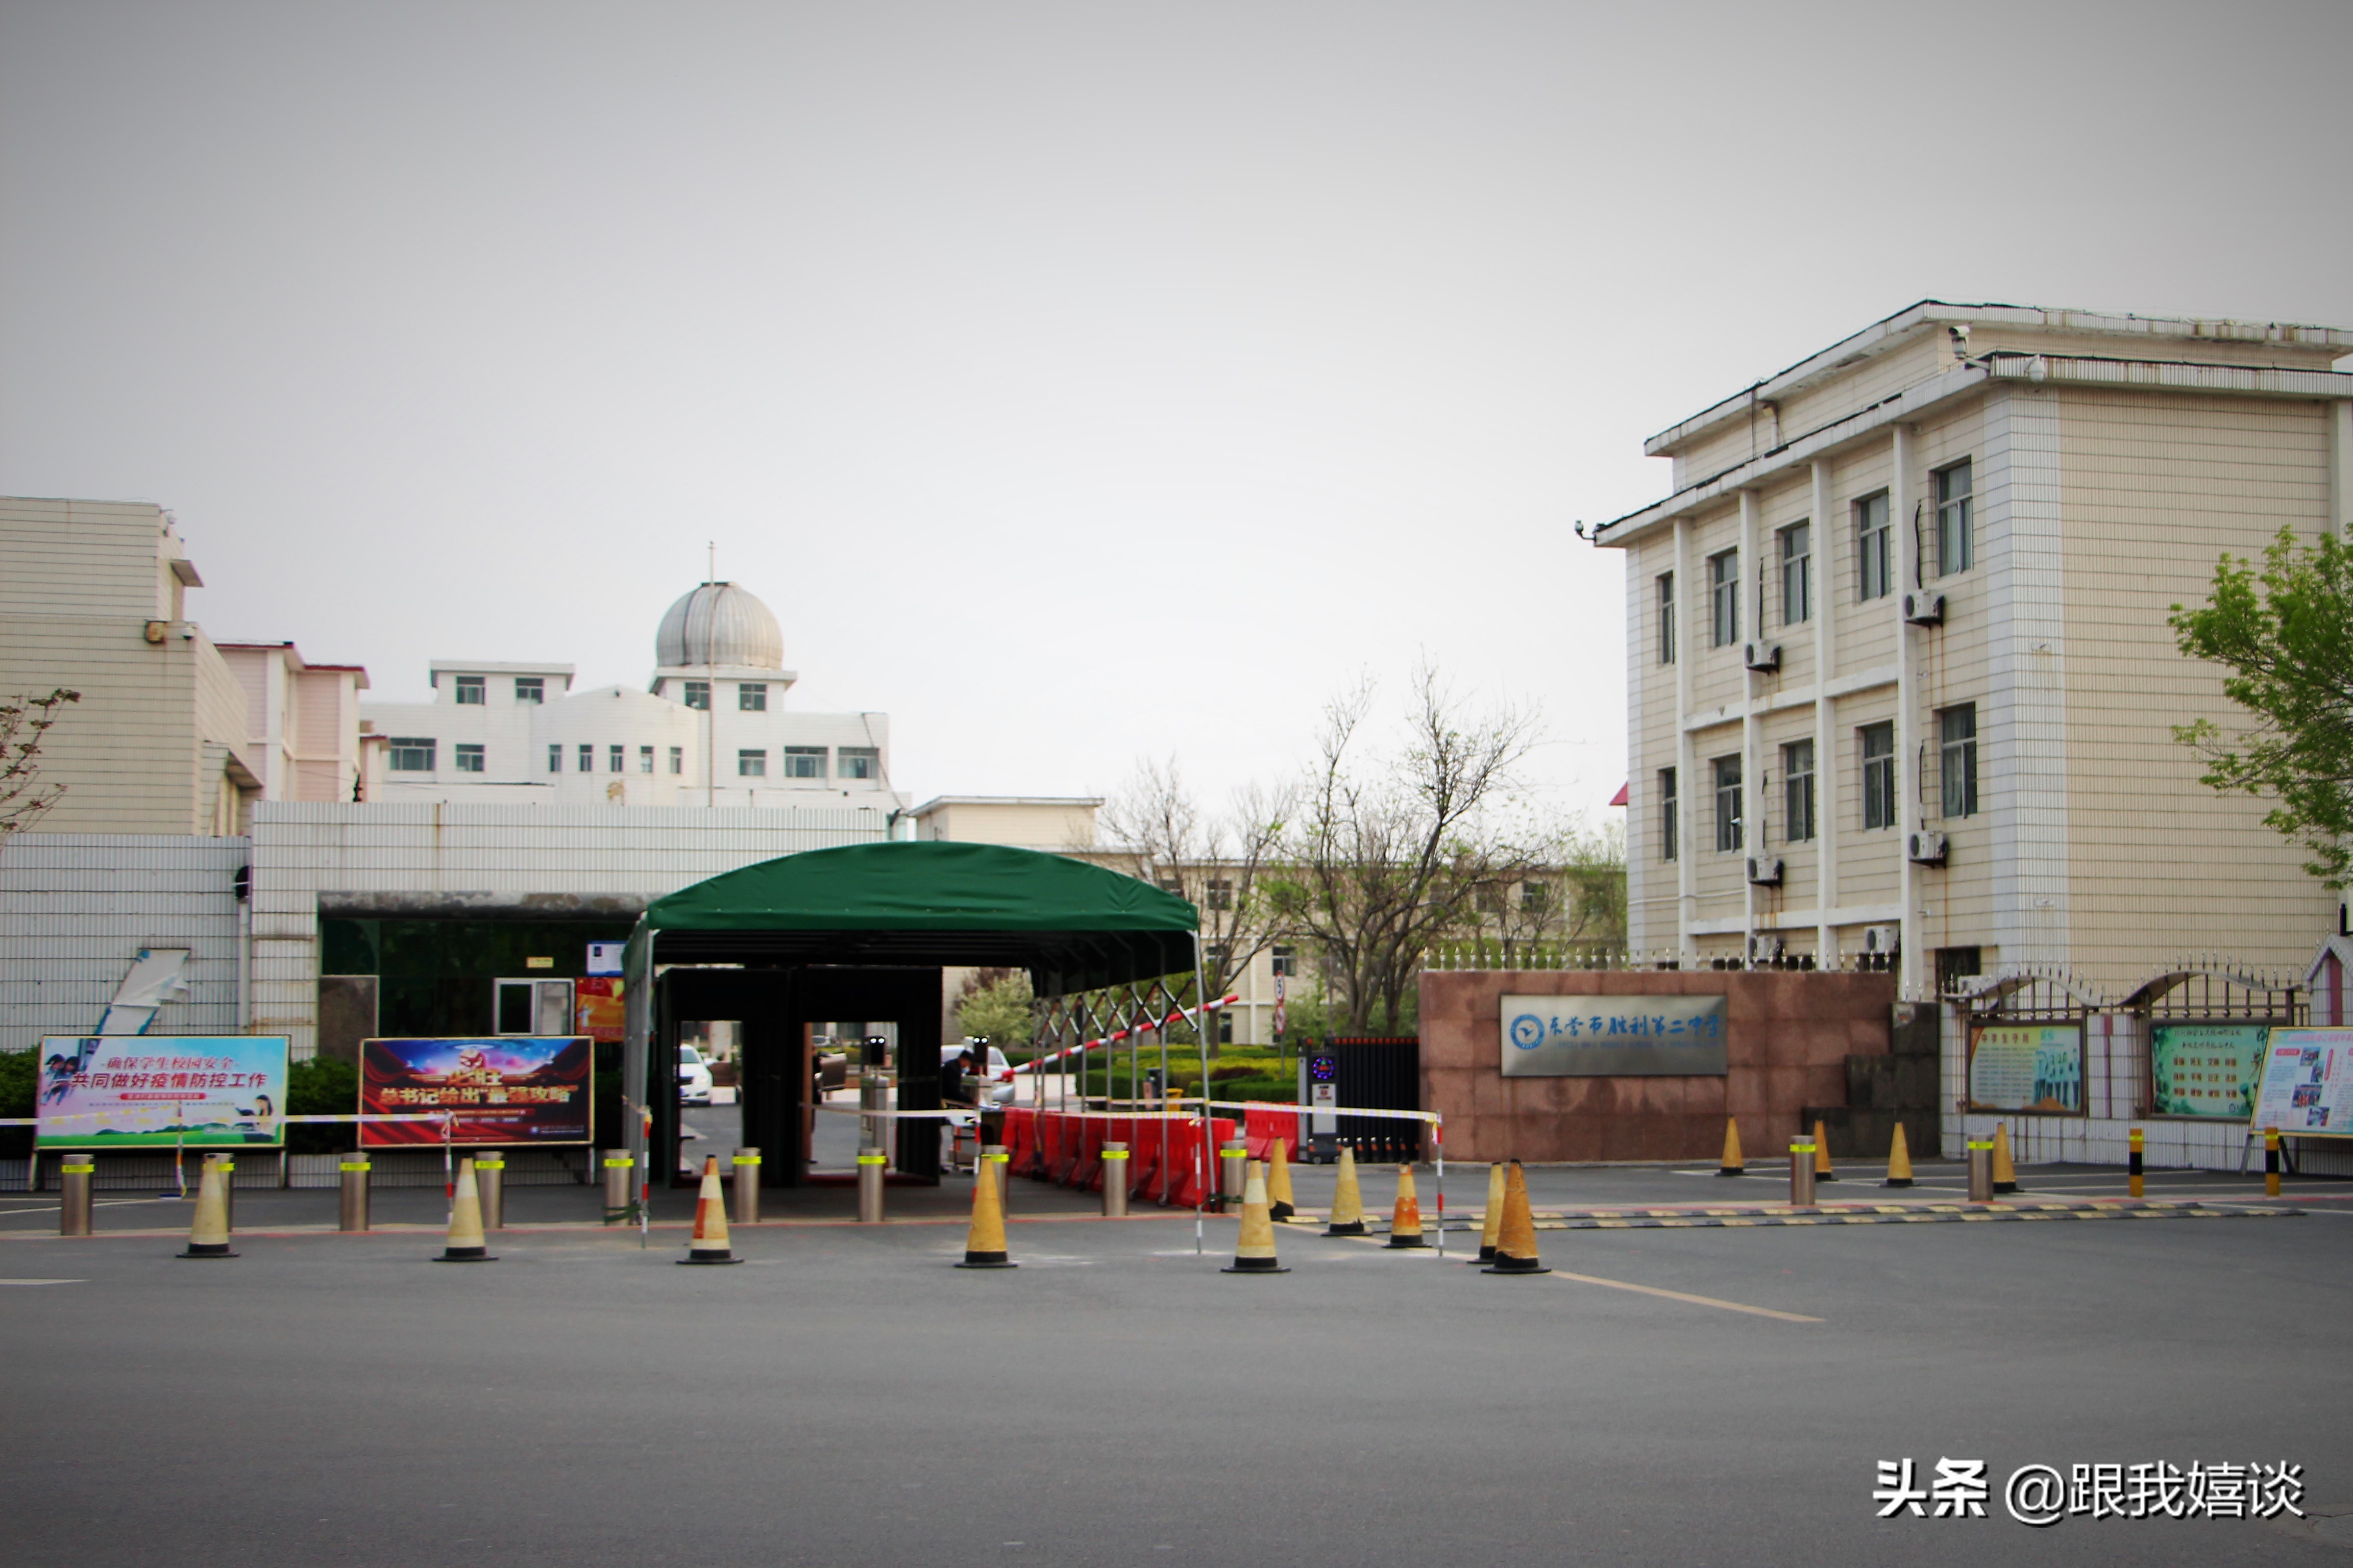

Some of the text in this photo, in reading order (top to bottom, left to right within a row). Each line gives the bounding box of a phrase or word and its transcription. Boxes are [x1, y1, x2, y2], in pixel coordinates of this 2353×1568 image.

[1549, 1014, 1719, 1037] 东营市胜利第二中学
[107, 1057, 234, 1071] 确保学生校园安全
[70, 1072, 268, 1089] 共同做好疫情防控工作
